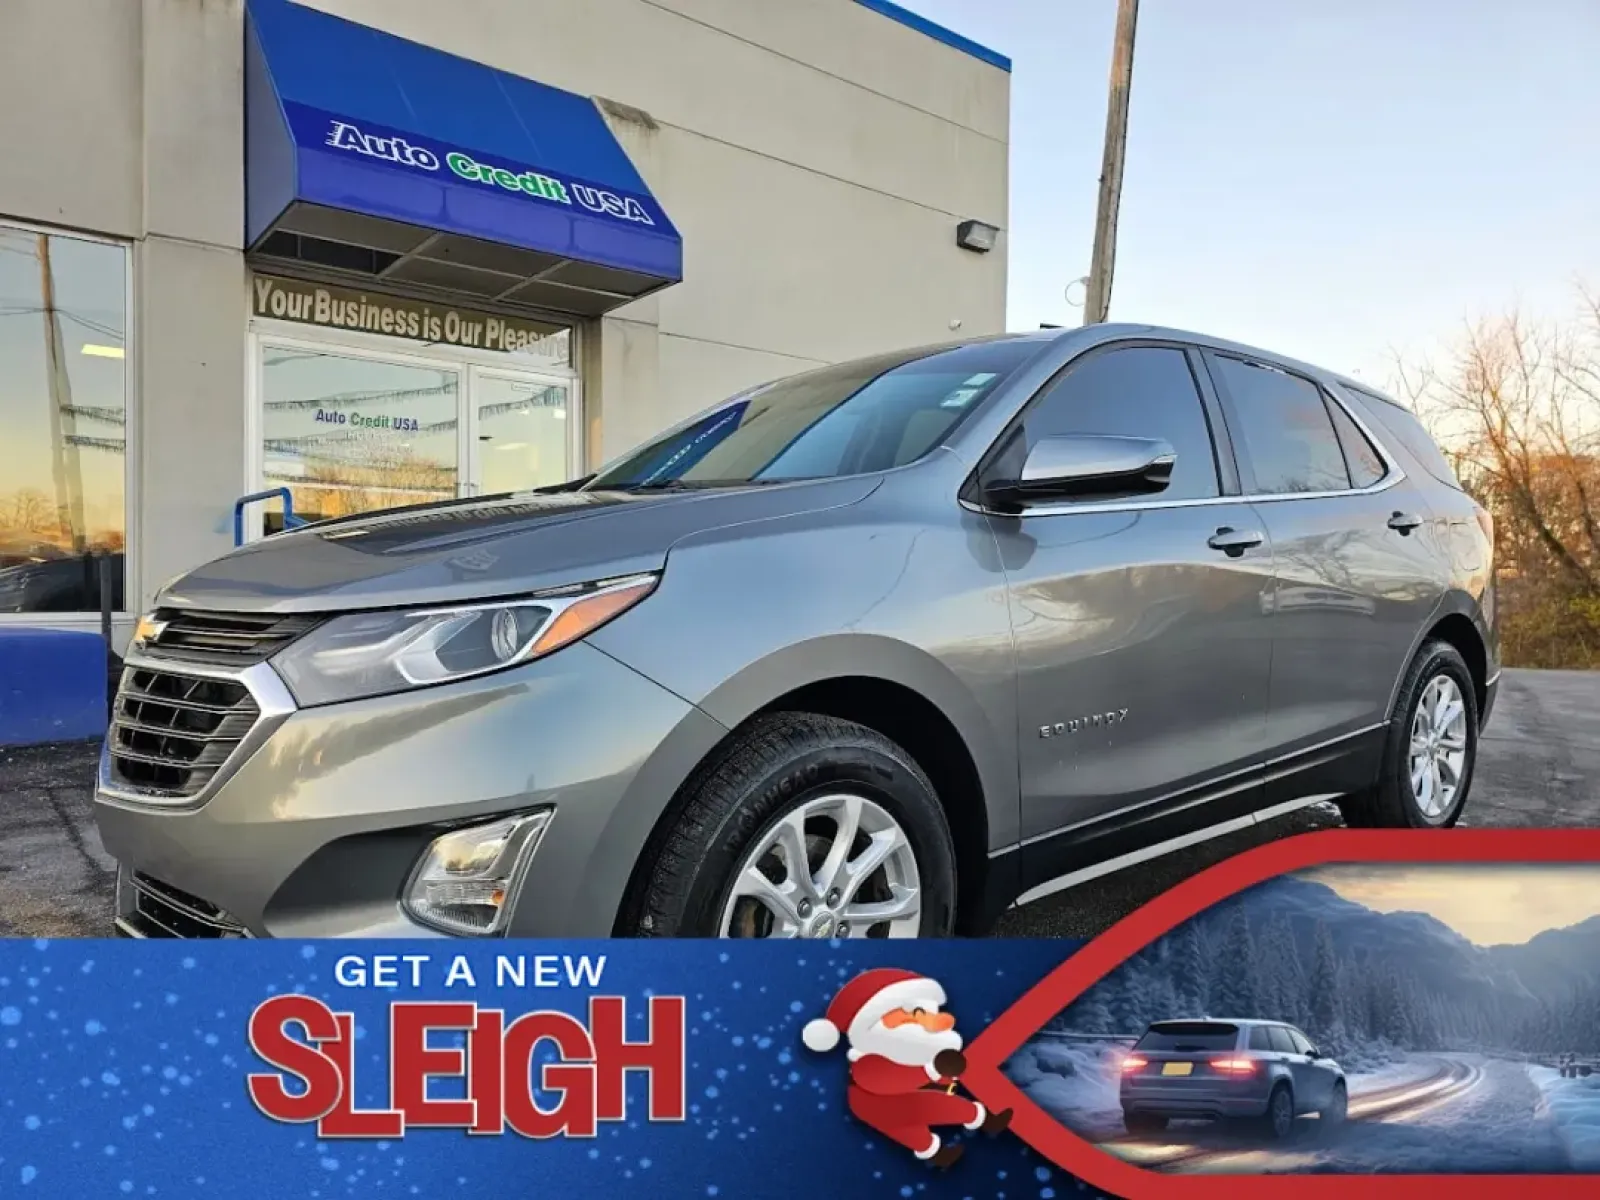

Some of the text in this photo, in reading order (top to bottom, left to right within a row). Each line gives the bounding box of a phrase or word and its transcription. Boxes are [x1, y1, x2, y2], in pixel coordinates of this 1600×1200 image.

[325, 119, 656, 226] Auto Credit USA
[254, 278, 314, 320] Your
[314, 288, 419, 337] Business
[423, 307, 441, 342] is
[444, 310, 483, 346] Our
[315, 408, 419, 432] Auto Credit USA
[1039, 707, 1128, 739] EQUINOX
